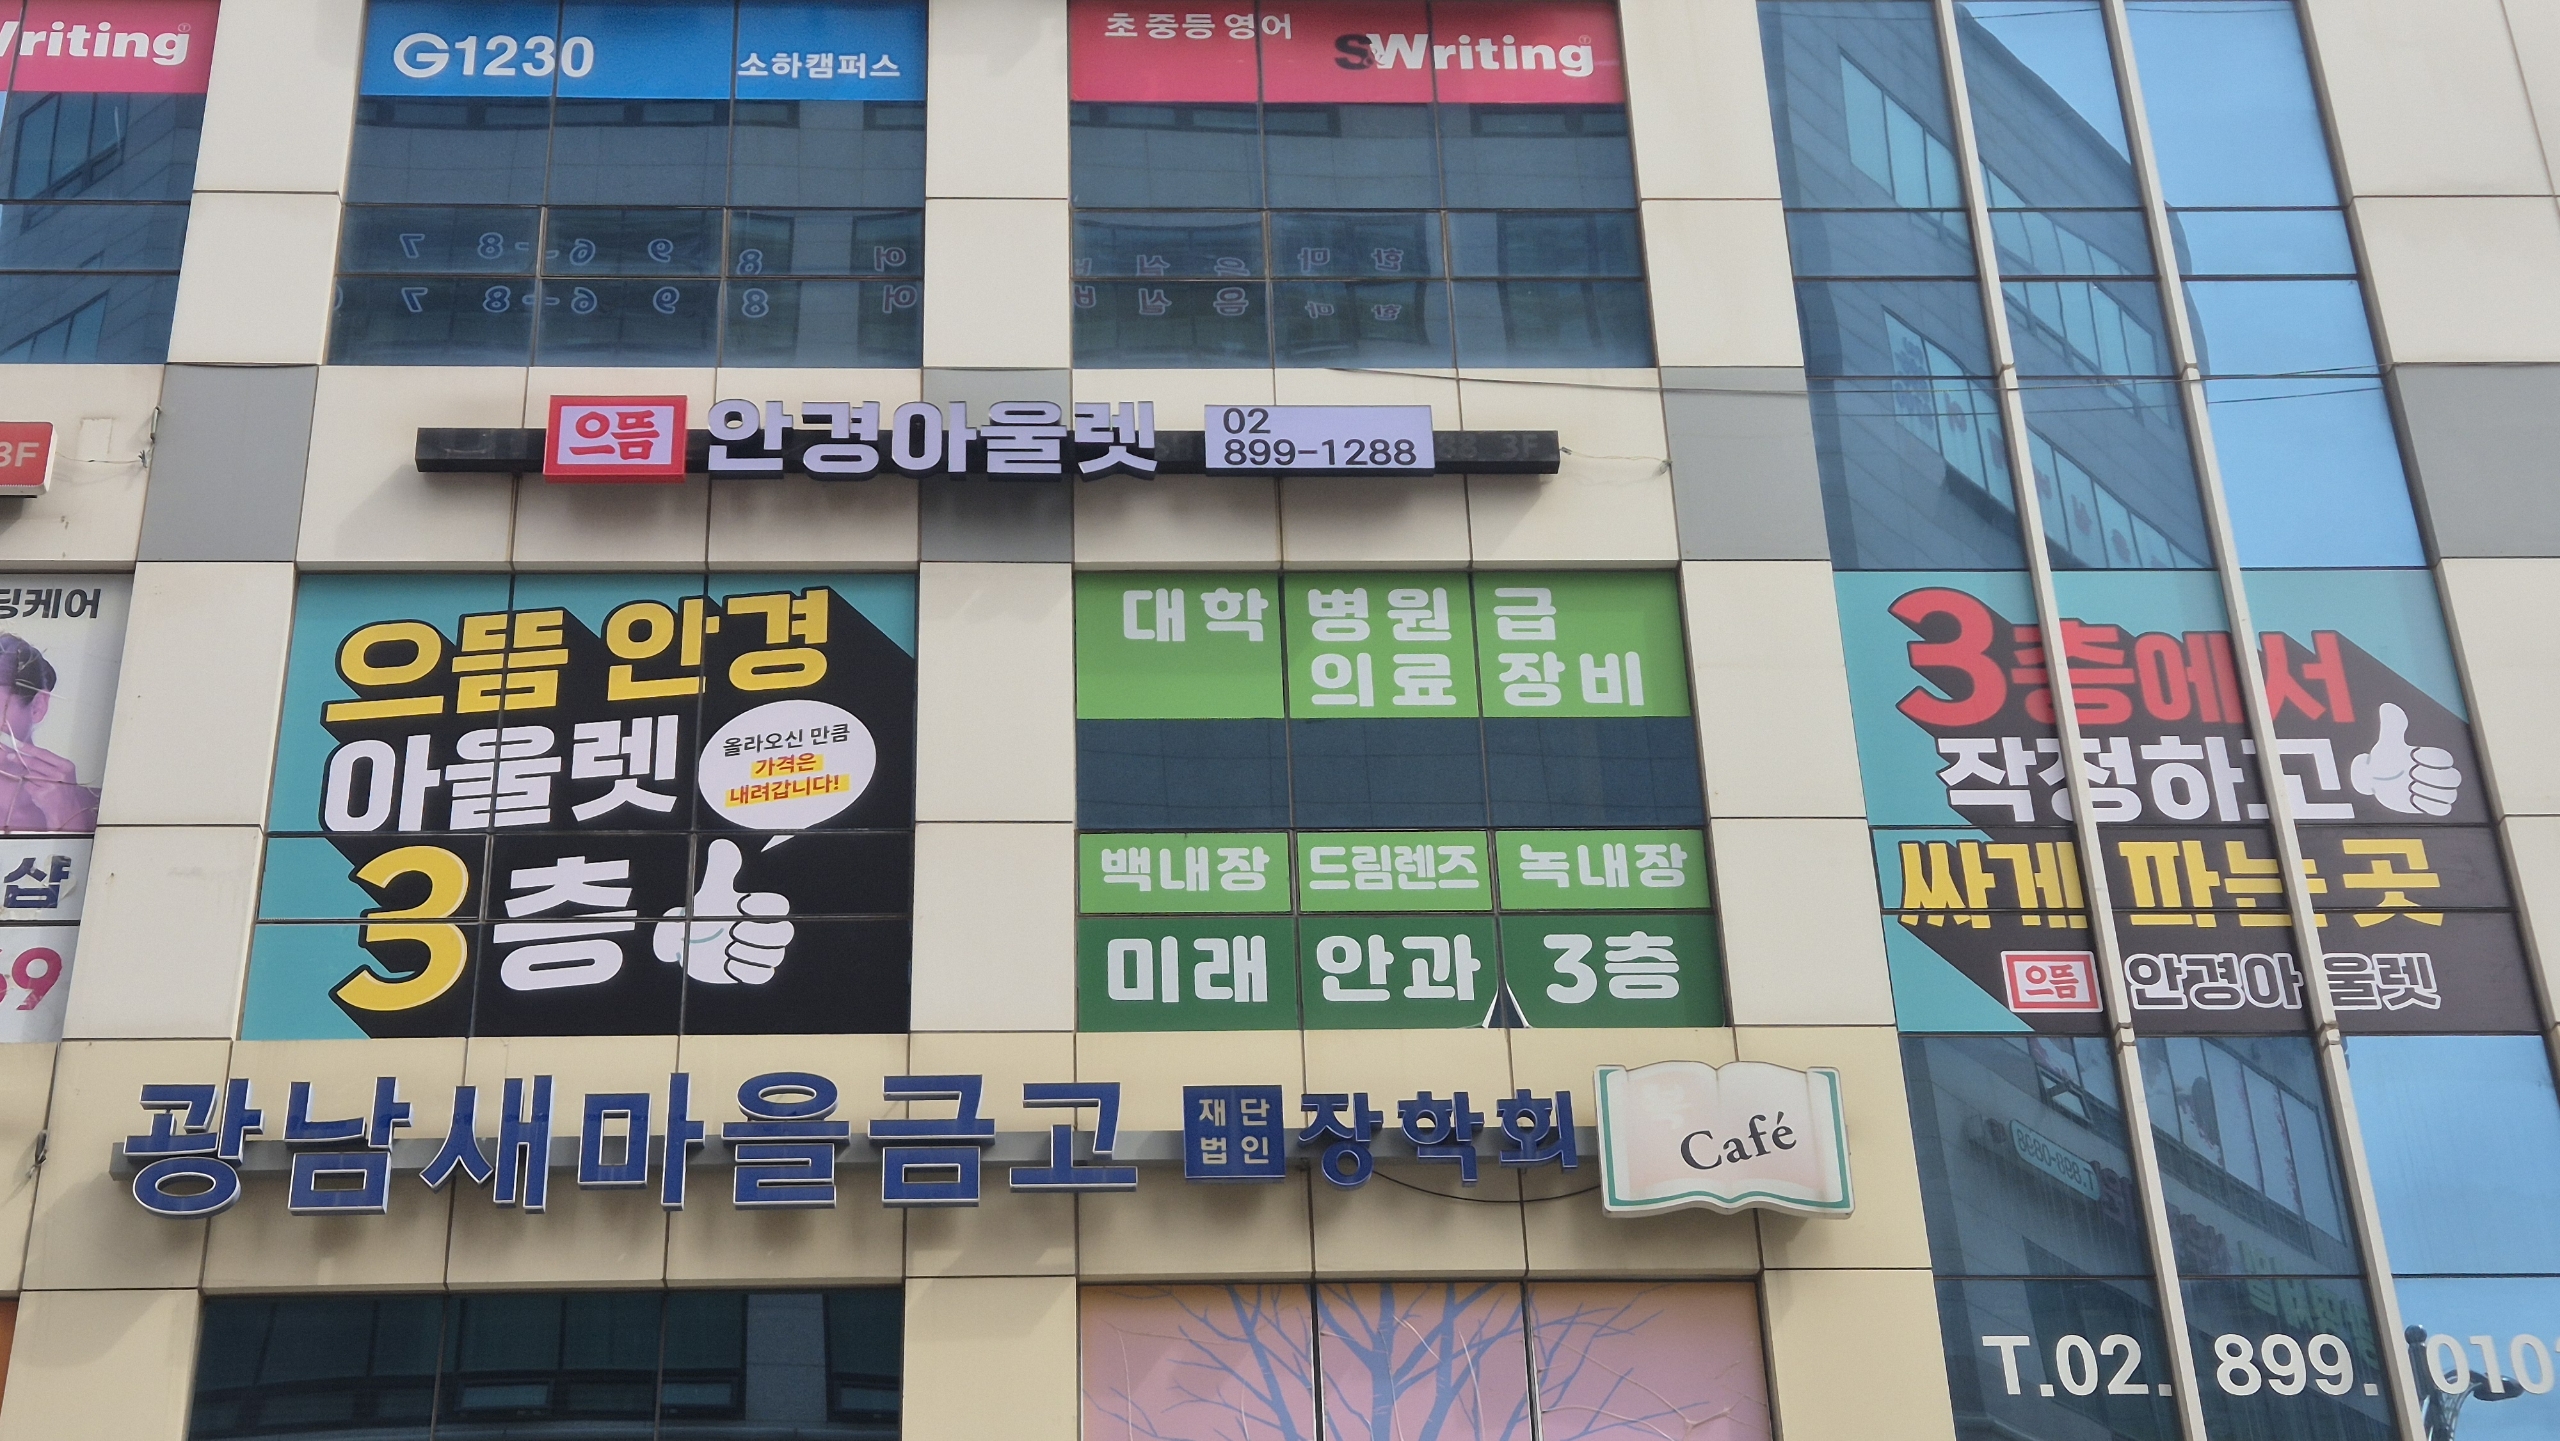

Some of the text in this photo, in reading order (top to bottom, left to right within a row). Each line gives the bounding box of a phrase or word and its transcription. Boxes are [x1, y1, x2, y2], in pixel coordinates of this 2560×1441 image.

[0, 21, 190, 66] riting
[393, 32, 595, 79] G1230
[737, 52, 902, 80] 소하캠퍼스
[569, 409, 660, 461] 으뜸
[706, 398, 1160, 479] 안경아울렛
[1222, 408, 1271, 435] 02
[1223, 438, 1418, 468] 899-1288
[1123, 587, 1269, 642] 대학
[326, 586, 830, 722] 으뜸 안경
[1311, 650, 1646, 708] 의료 장비
[1887, 586, 2357, 727] 3층에서
[723, 723, 851, 757] 올라오신 만큼
[755, 752, 817, 776] 가격은
[324, 713, 680, 832] 아울렛
[730, 774, 839, 804] 내려갑니다!
[1937, 734, 2356, 823] 작정하고
[4, 855, 72, 909] 샵
[1100, 842, 1688, 893] 백내장 드림렌즈 녹내장
[1899, 838, 2445, 929] 싸게 파는 곳
[336, 845, 637, 1011] 3층
[0, 947, 63, 1011] 9
[1106, 929, 1682, 1006] 미래 안과 3층
[2025, 952, 2442, 1011] 으뜸 안경아울렛
[1198, 1097, 1271, 1127] 재단
[1298, 1088, 1579, 1188] 장학회
[122, 1071, 1139, 1217] 광남새마을금고
[1199, 1135, 1271, 1167] 법인
[1678, 1110, 1799, 1173] Café
[1981, 1333, 2560, 1398] T.02. 899. 010
